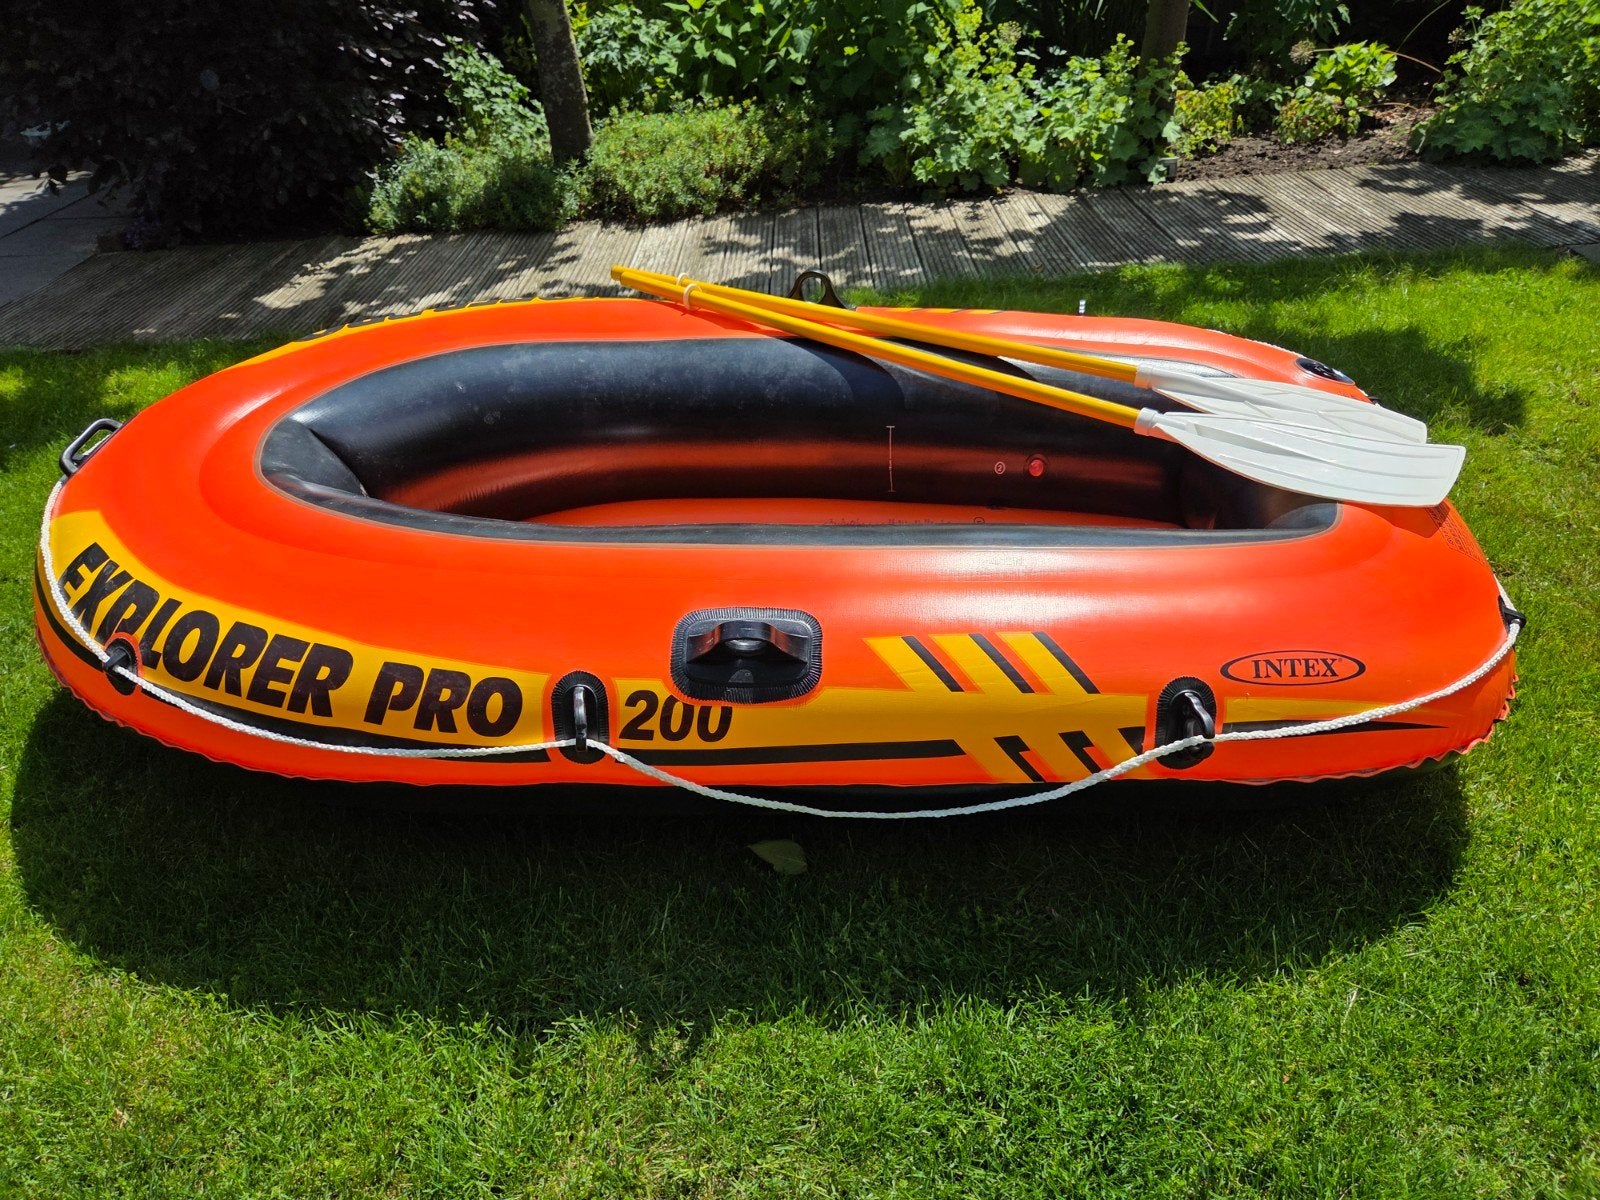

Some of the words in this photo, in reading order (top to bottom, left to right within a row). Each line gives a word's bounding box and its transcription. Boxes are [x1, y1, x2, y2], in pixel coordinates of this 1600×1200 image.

[58, 541, 353, 718] EXPLORER
[364, 661, 523, 738] PRO
[619, 689, 733, 743] 200
[1252, 657, 1340, 679] INTEX
